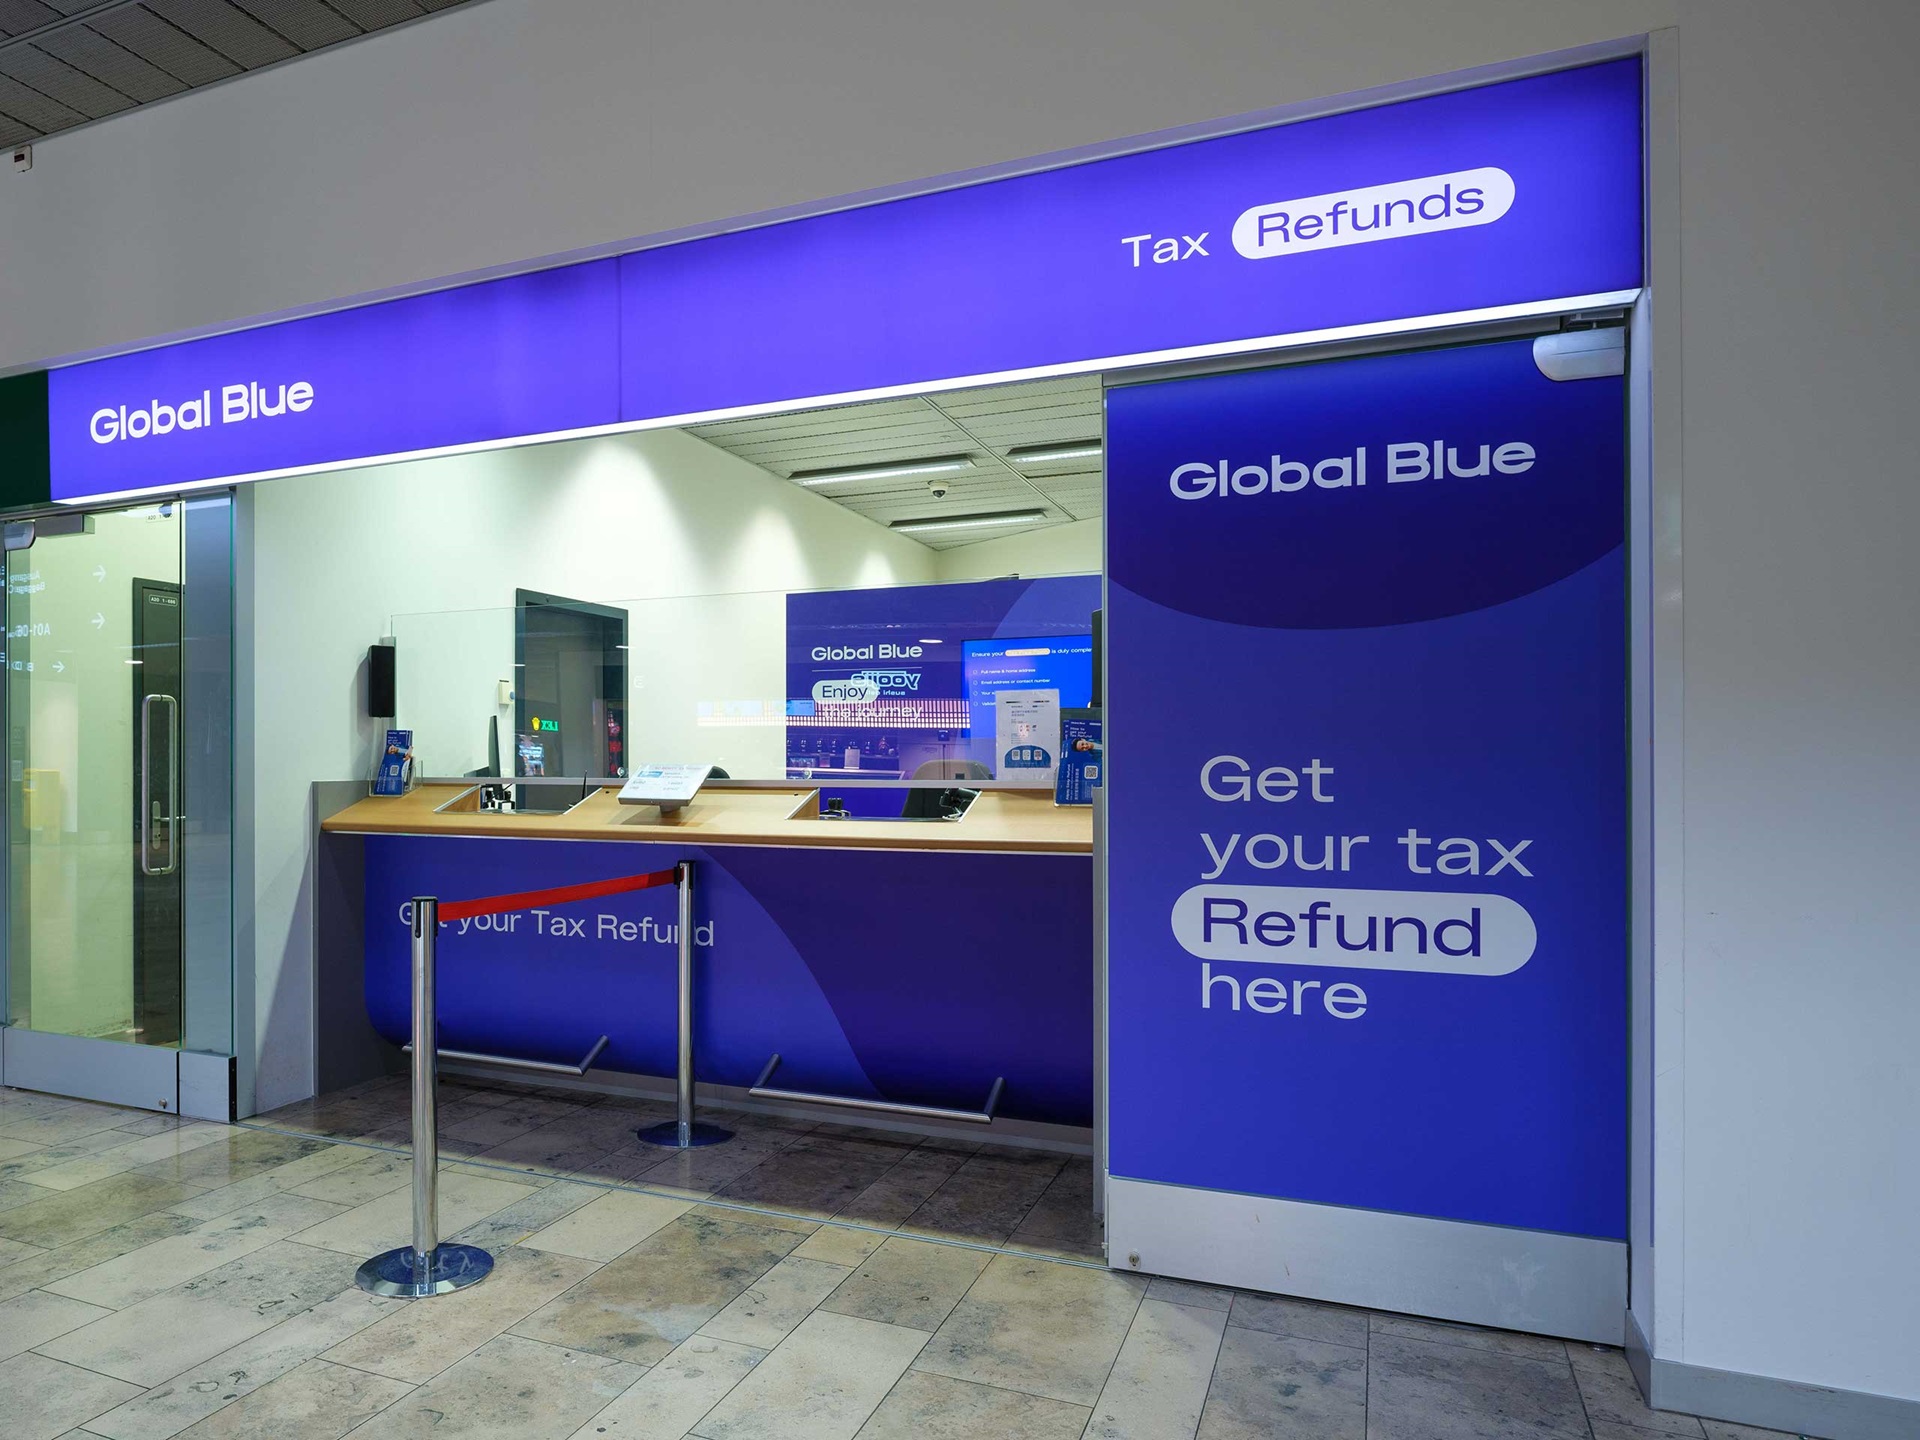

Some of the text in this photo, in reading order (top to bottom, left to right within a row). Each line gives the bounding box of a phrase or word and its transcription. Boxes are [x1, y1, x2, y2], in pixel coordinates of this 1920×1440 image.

[1121, 183, 1485, 268] Tax Refunds
[89, 381, 314, 444] Global Blue
[1169, 439, 1536, 500] Global Blue
[811, 643, 923, 661] Global Blue
[1057, 647, 1069, 655] duly
[822, 684, 868, 701] Enjoy
[824, 702, 923, 722] the journey
[1200, 755, 1334, 803] Get
[1200, 828, 1534, 880] your tax
[457, 913, 522, 935] your
[530, 909, 586, 938] Tax
[597, 913, 714, 947] Refud
[1202, 897, 1482, 958] Refund
[1202, 962, 1368, 1020] here
